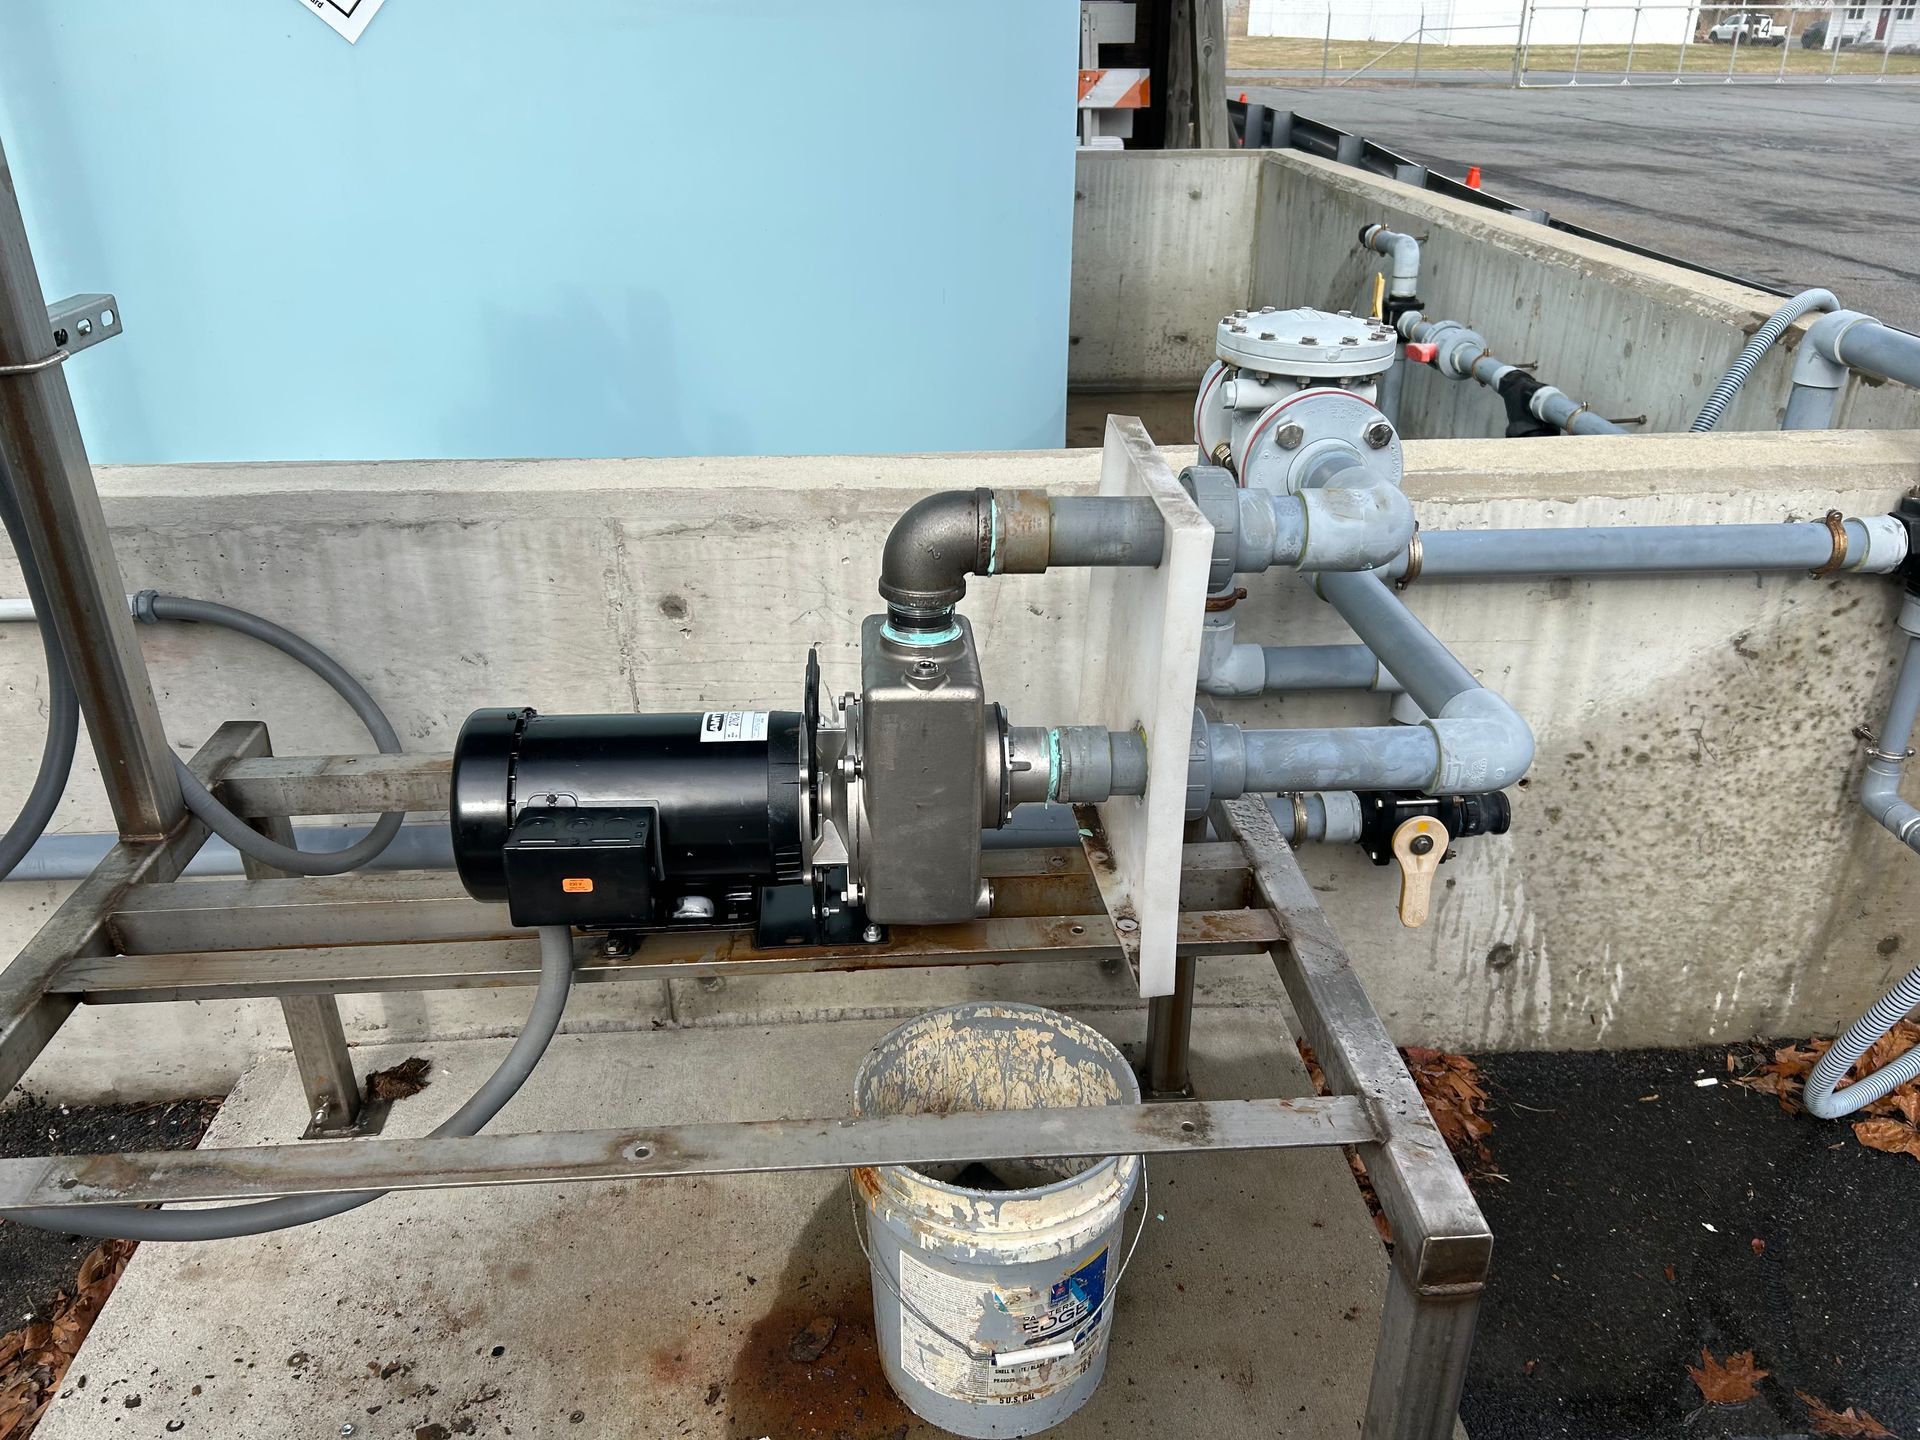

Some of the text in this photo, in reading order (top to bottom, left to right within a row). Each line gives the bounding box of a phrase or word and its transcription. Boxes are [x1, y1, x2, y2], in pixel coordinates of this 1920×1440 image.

[1761, 20, 1771, 36] 4
[709, 713, 722, 731] AMT
[1023, 1301, 1076, 1321] PATERS
[1022, 1393, 1036, 1402] GAL
